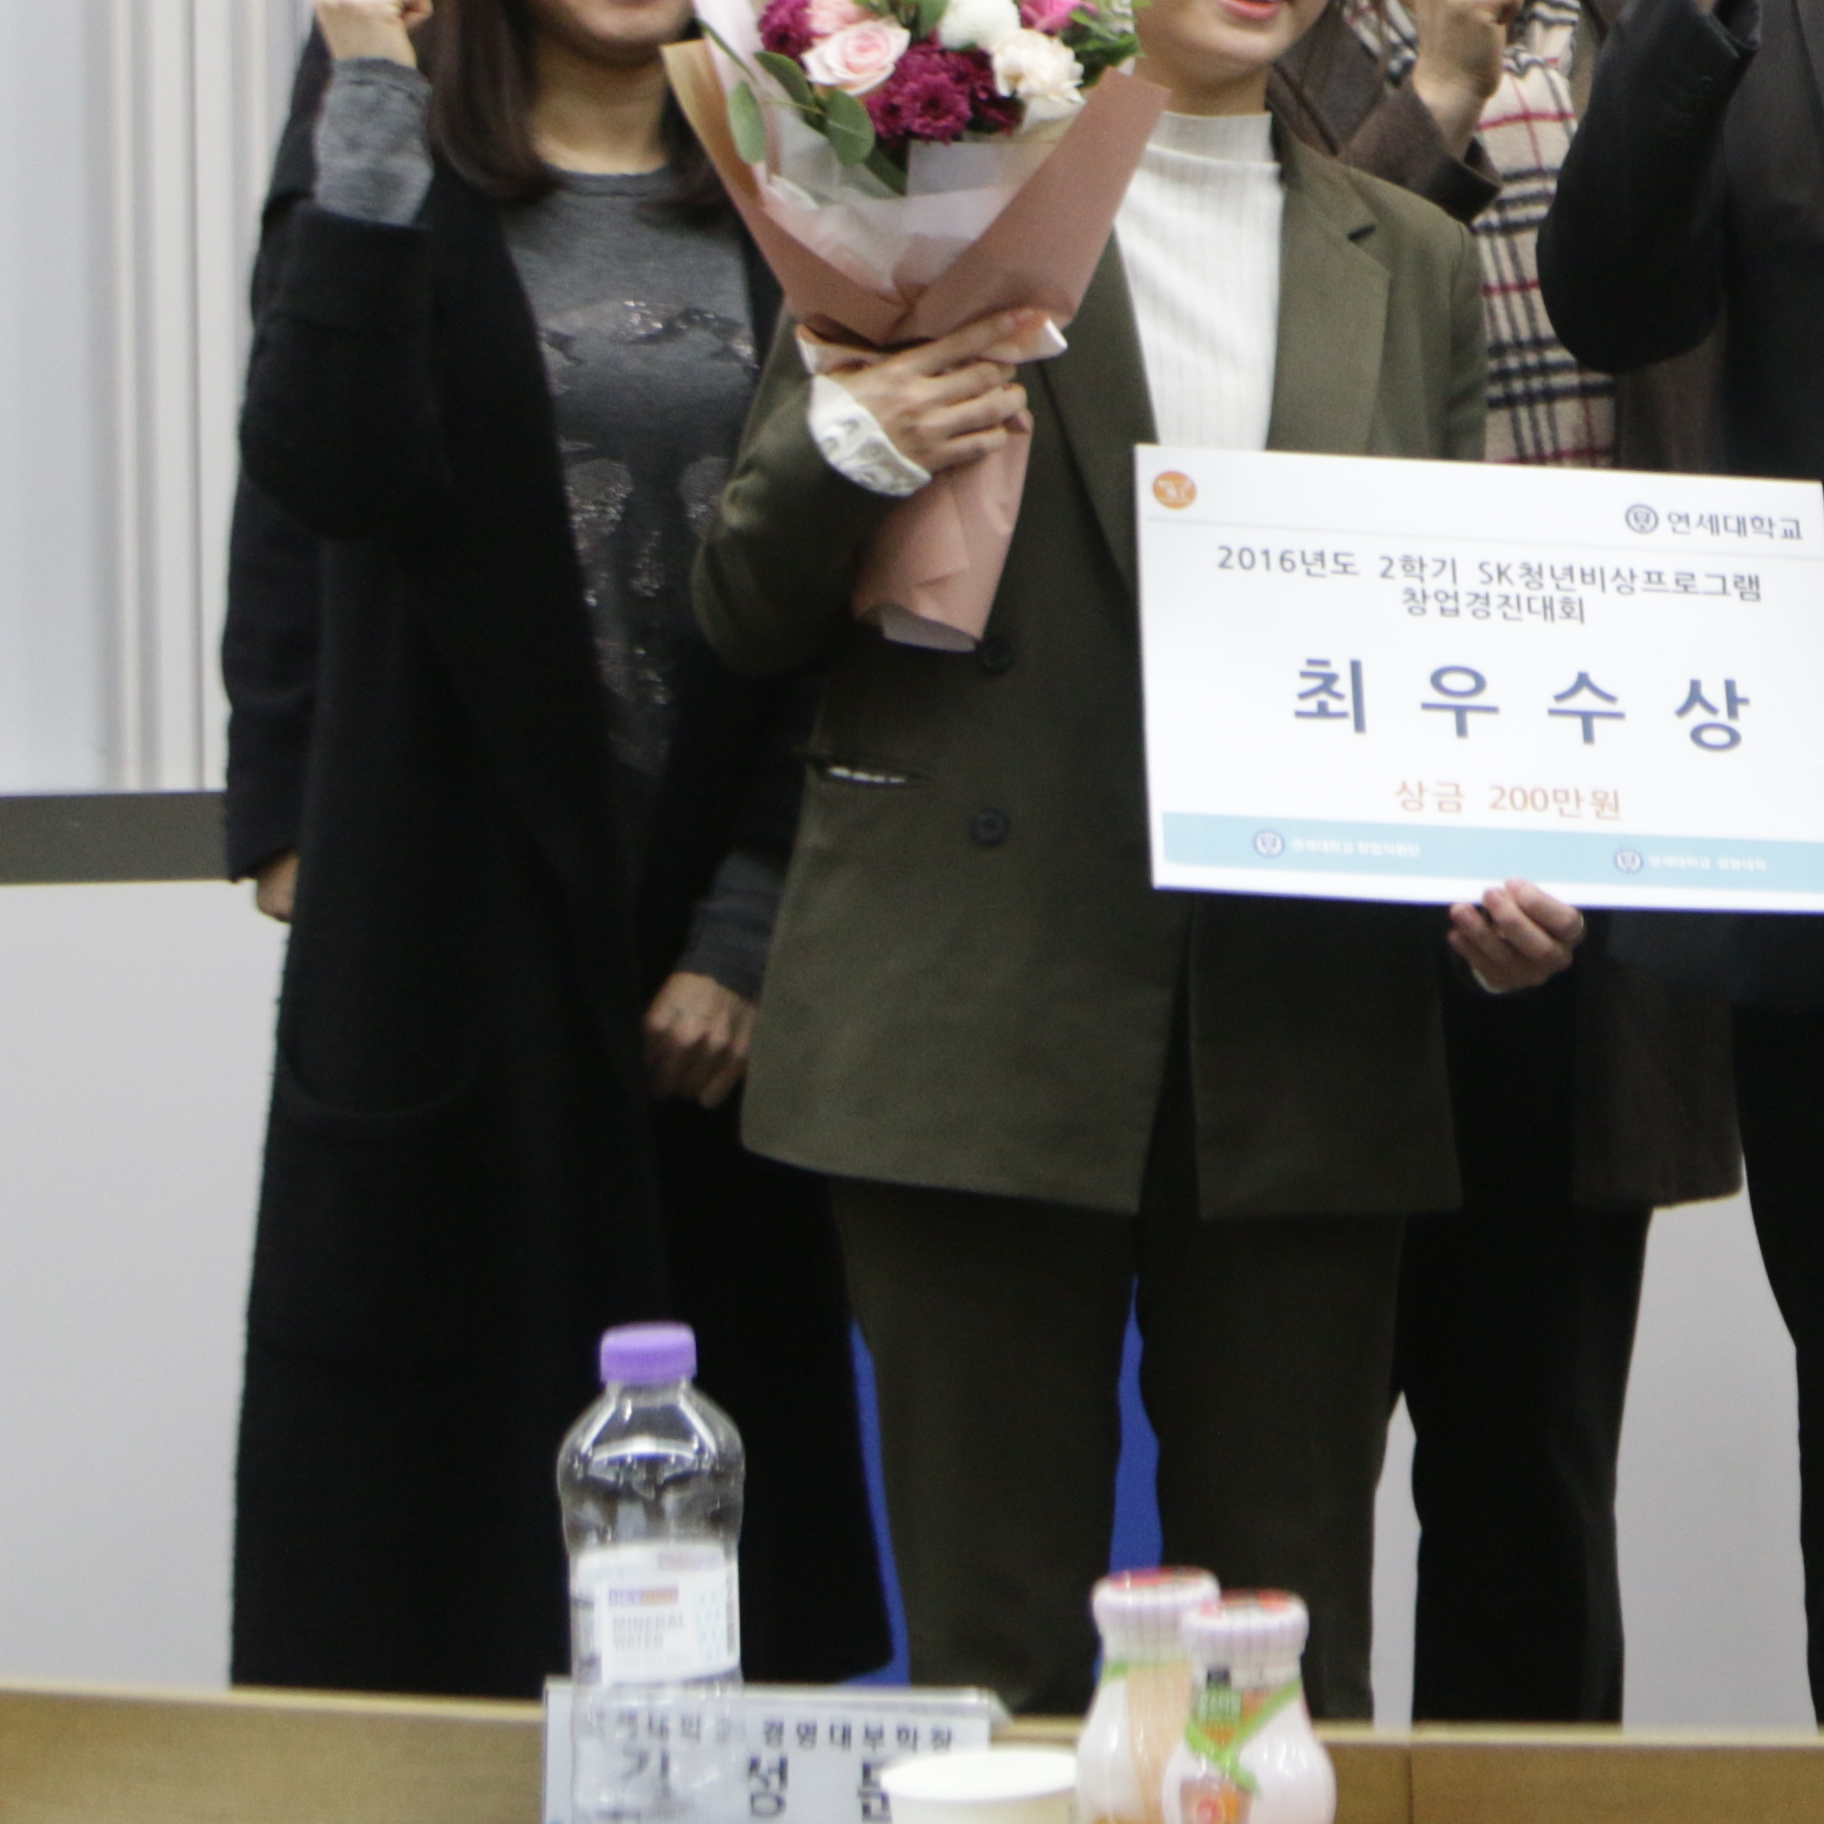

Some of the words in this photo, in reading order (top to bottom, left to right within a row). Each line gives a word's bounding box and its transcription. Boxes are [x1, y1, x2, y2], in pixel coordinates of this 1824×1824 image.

[1667, 509, 1804, 542] 연세대학교
[1216, 545, 1361, 578] 2016년도
[1378, 554, 1459, 585] 2학기
[1477, 559, 1763, 603] SK청년비상프로그램
[1400, 586, 1587, 625] 창업경진대회
[1397, 781, 1465, 815] 상금
[1489, 786, 1622, 821] 200만원
